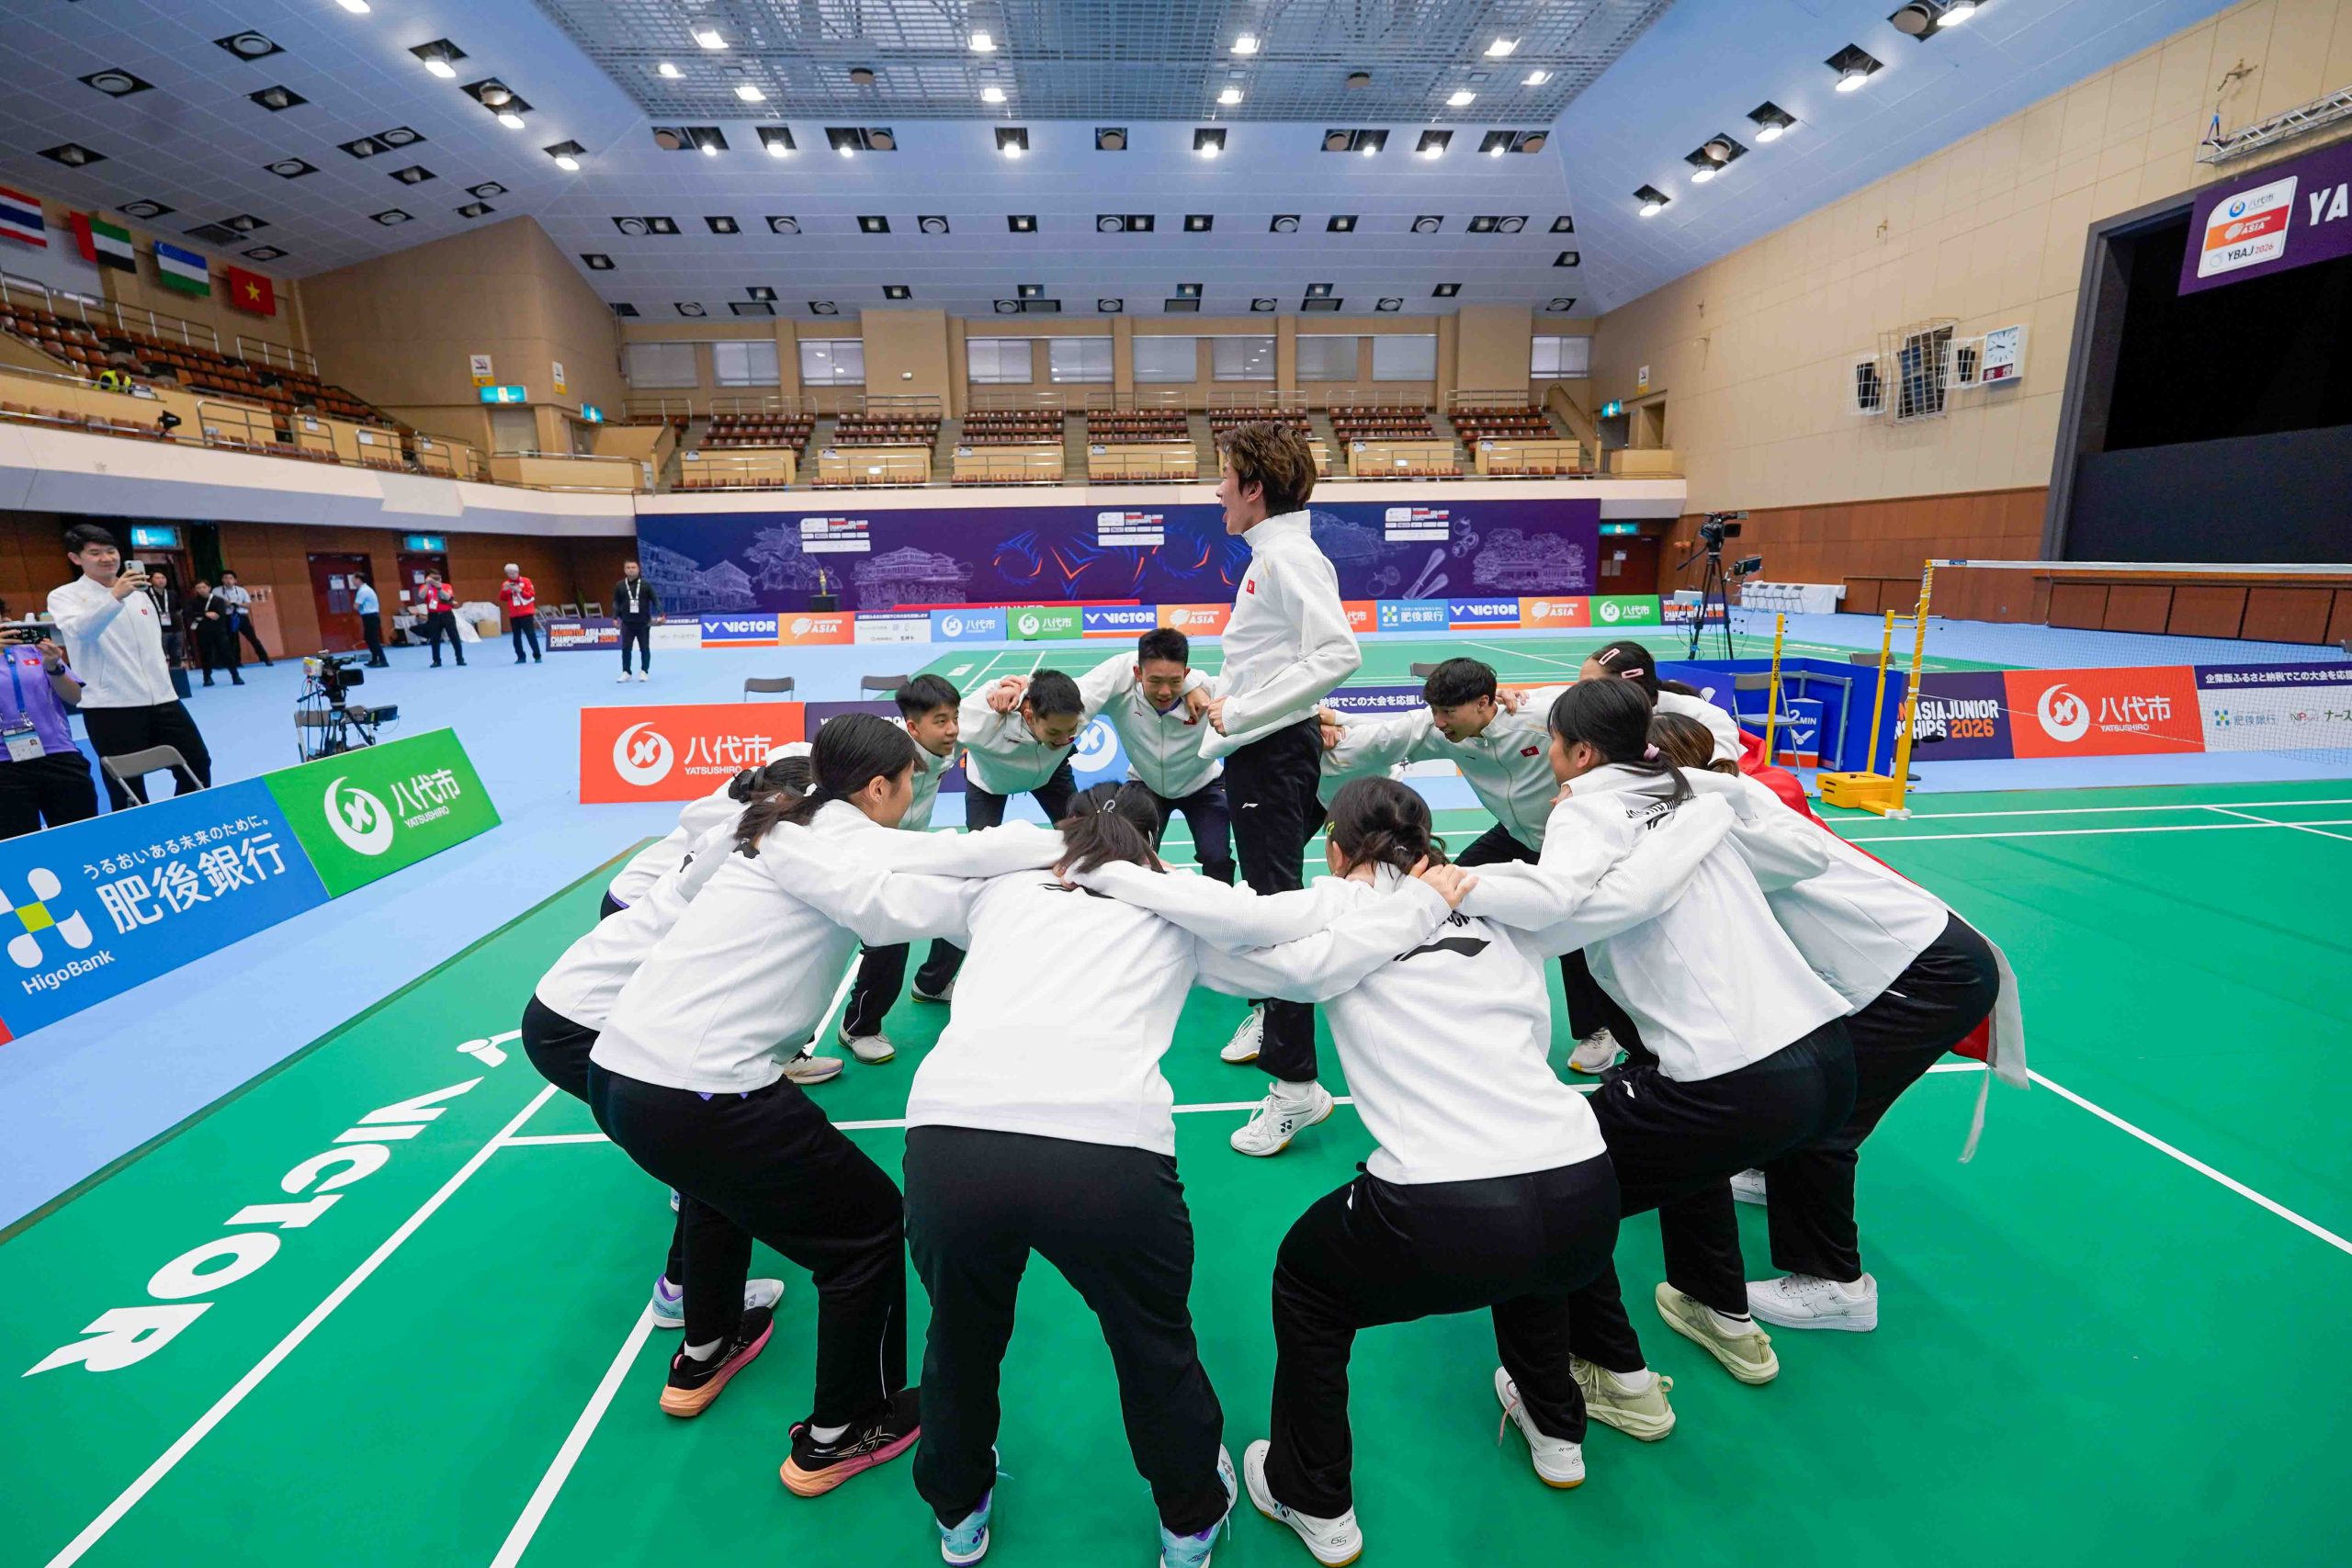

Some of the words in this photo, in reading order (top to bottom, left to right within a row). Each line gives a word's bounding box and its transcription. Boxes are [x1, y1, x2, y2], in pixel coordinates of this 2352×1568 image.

[2309, 183, 2348, 227] YA
[2227, 245, 2255, 262] YBAJ
[1104, 612, 1156, 625] VICTOR
[1189, 615, 1215, 625] ASIA
[1467, 604, 1518, 616] VICTOR
[1549, 608, 1574, 617] ASIA
[722, 620, 777, 633] VICTOR
[811, 625, 838, 633] ASIA
[1319, 695, 1429, 708] 納税でこの大会を応援し
[1946, 699, 1999, 719] JUNIOR
[2098, 695, 2171, 723] 八代市
[1800, 716, 1817, 726] MIN
[1951, 718, 1995, 739] 2026
[684, 735, 772, 766] 八代市
[684, 765, 742, 776] YATSUSHIRO
[390, 769, 460, 817] 八代市
[404, 805, 450, 829] YATSUSHIRO
[83, 814, 269, 881] うるおいある未来のために。
[96, 832, 286, 935] 肥後銀行
[21, 949, 115, 995] HigoBank
[20, 1076, 486, 1379] VICTOR
